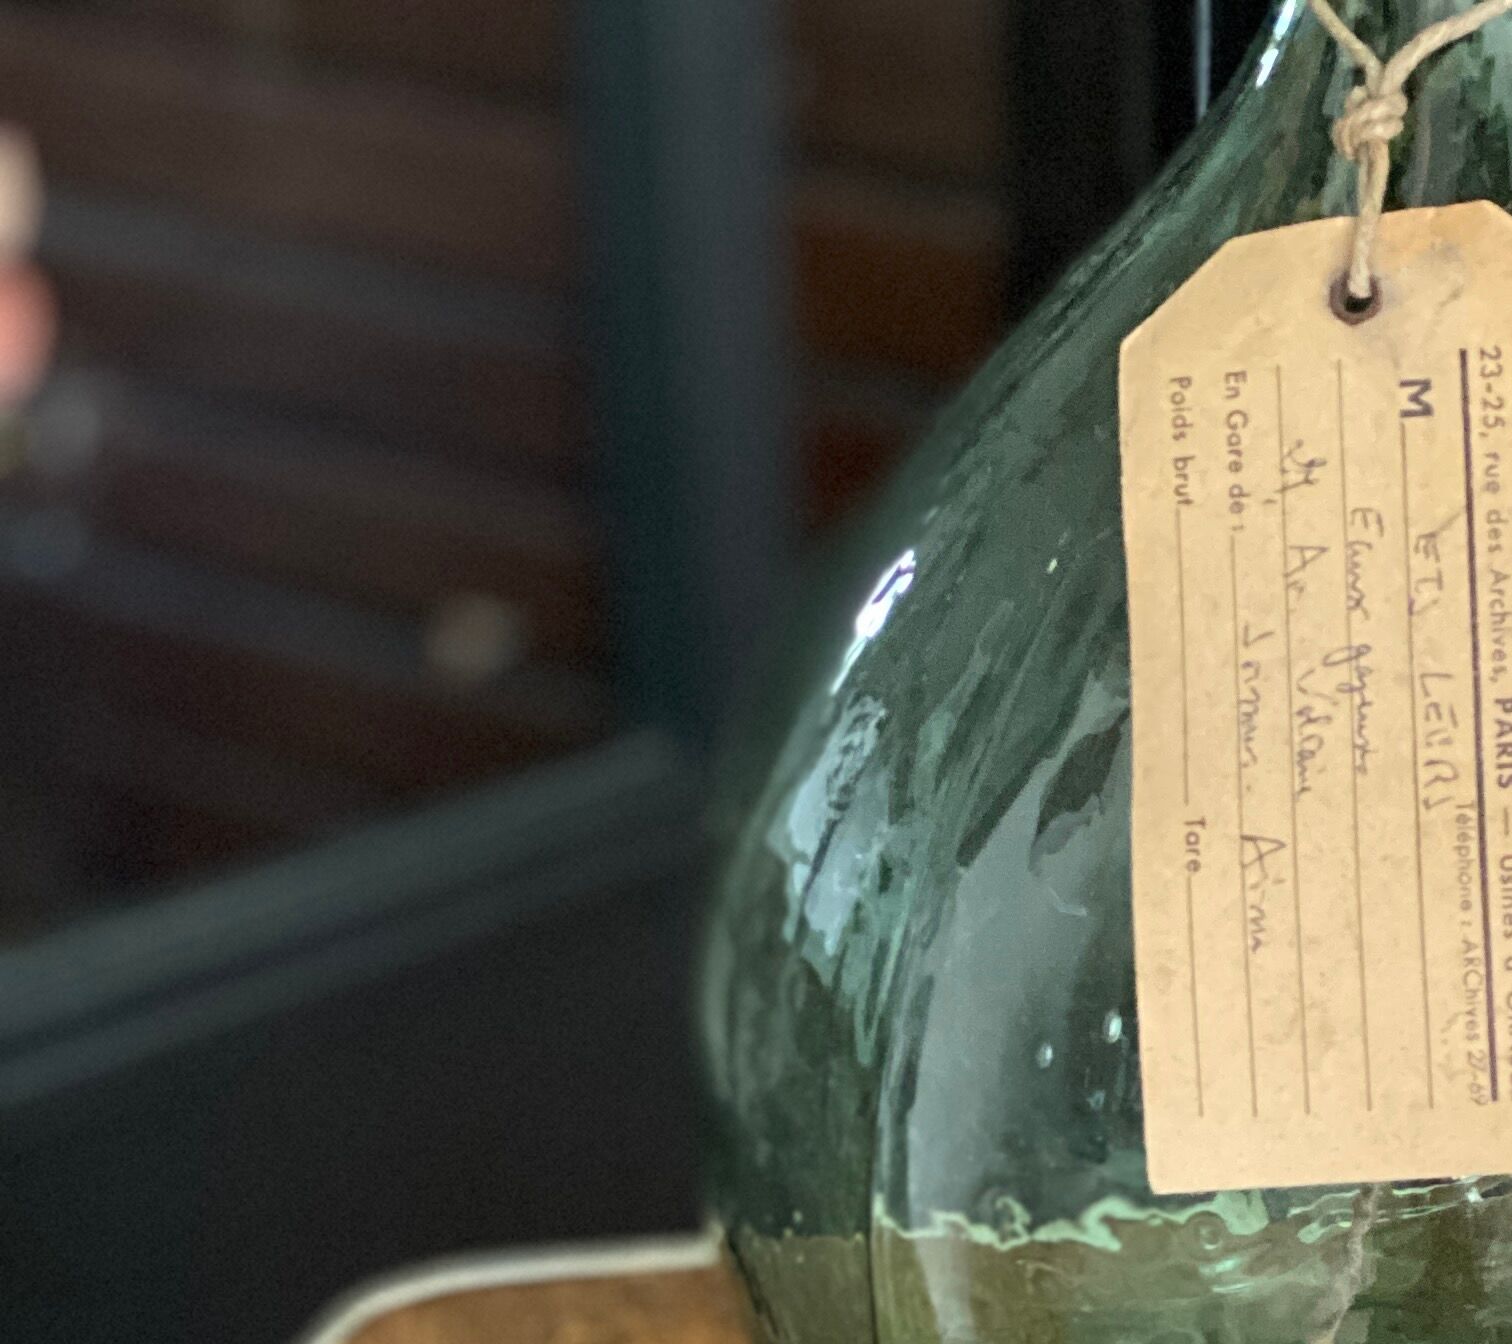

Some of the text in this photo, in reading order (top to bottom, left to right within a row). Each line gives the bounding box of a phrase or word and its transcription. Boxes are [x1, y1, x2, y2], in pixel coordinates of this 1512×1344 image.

[1224, 371, 1248, 399] En
[1400, 378, 1434, 418] M
[1478, 345, 1505, 438] 23-25,
[1170, 377, 1196, 505] Poids brut
[1226, 410, 1249, 473] Gare
[1483, 452, 1503, 493] rue
[1486, 509, 1510, 553] des
[1184, 817, 1206, 872] Tare
